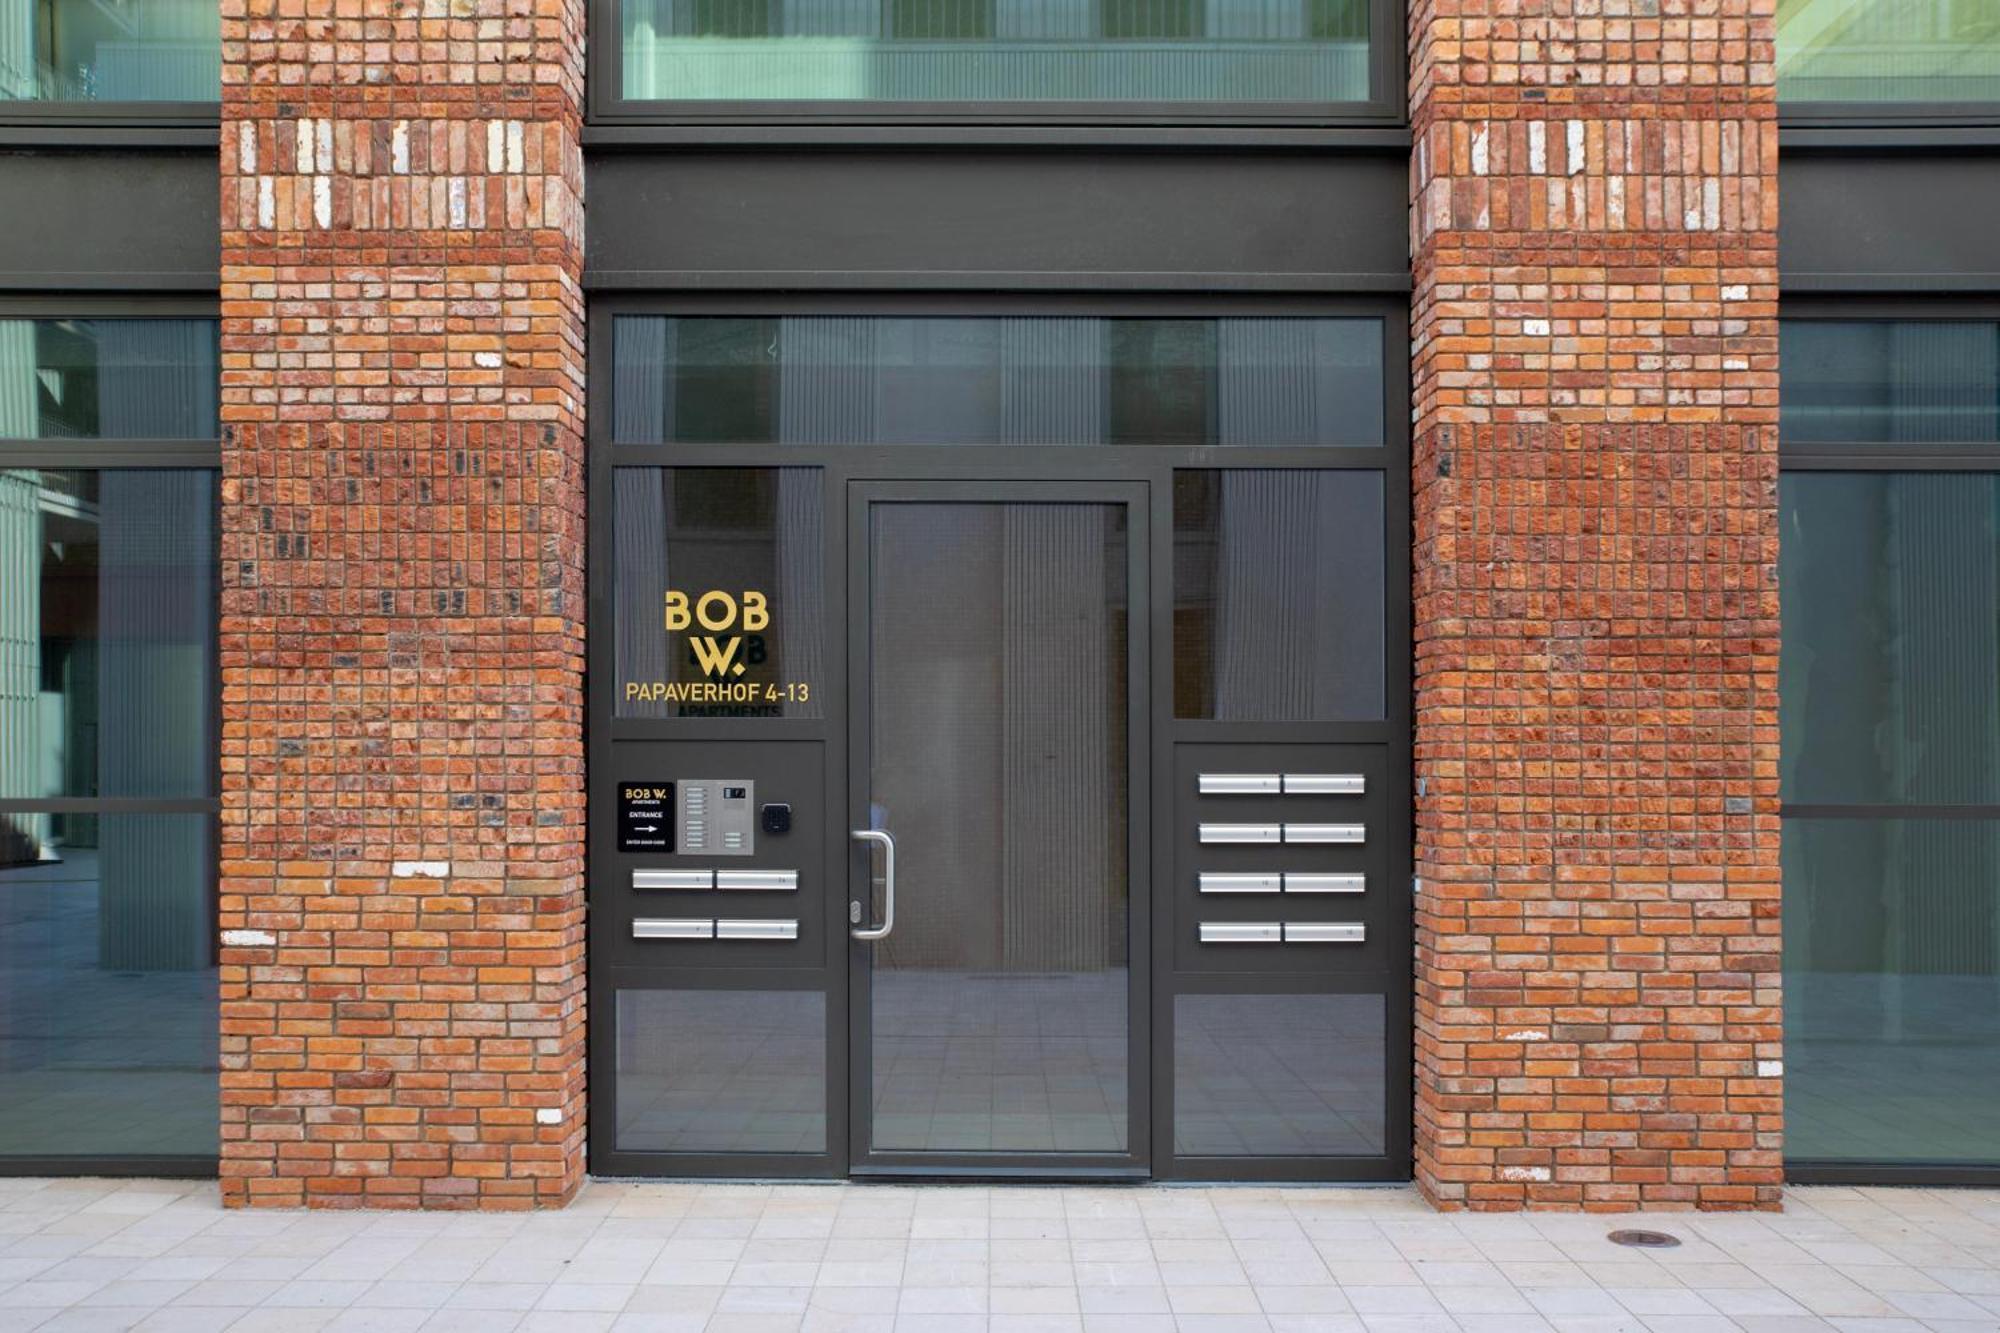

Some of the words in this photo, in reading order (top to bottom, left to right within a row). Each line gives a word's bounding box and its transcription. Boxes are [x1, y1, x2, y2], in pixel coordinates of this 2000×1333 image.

[665, 590, 769, 631] BOB
[689, 636, 746, 676] W.
[626, 682, 760, 702] PAPAVERHOF
[765, 683, 809, 702] 4-13
[625, 788, 651, 800] BOB
[653, 788, 667, 800] W.
[628, 811, 664, 819] ENTRANCE
